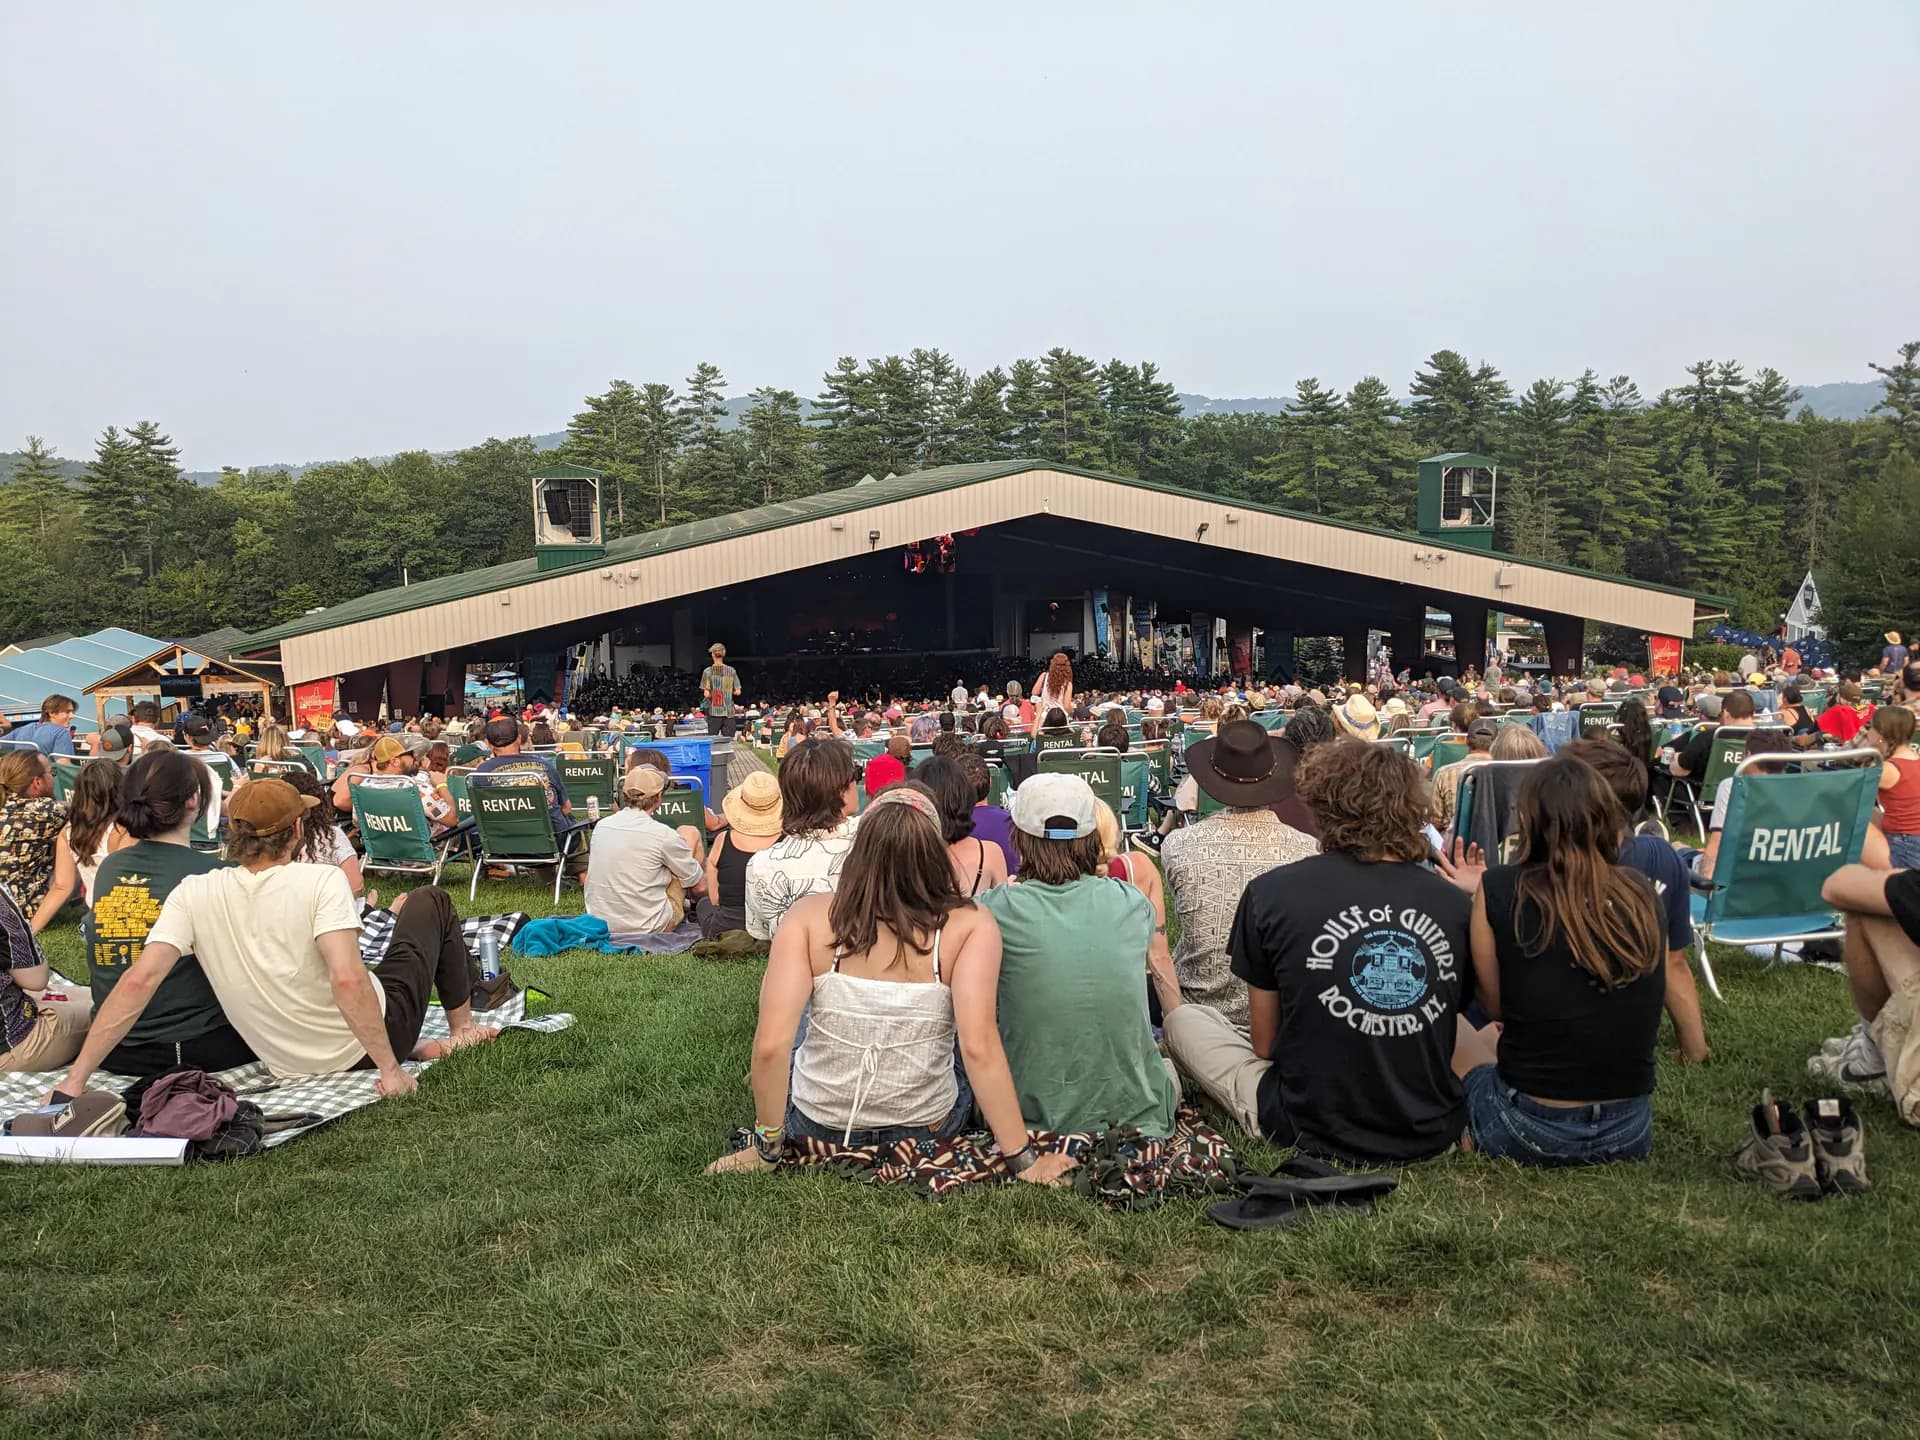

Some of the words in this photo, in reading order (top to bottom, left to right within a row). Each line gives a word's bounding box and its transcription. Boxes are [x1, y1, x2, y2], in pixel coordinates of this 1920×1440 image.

[1584, 717, 1614, 725] RENTAL
[1043, 739, 1074, 749] RENTAL
[565, 767, 604, 777] RENTAL
[482, 797, 536, 812] RENTAL
[655, 801, 691, 815] NTAL
[364, 812, 413, 832] RENTAL
[1748, 821, 1842, 862] RENTAL
[1306, 905, 1370, 970] HOUSE
[1369, 904, 1393, 922] of
[1400, 908, 1457, 982] GUITARS
[1317, 985, 1423, 1036] ROCHESTER,
[1420, 993, 1447, 1024] N.Y.
